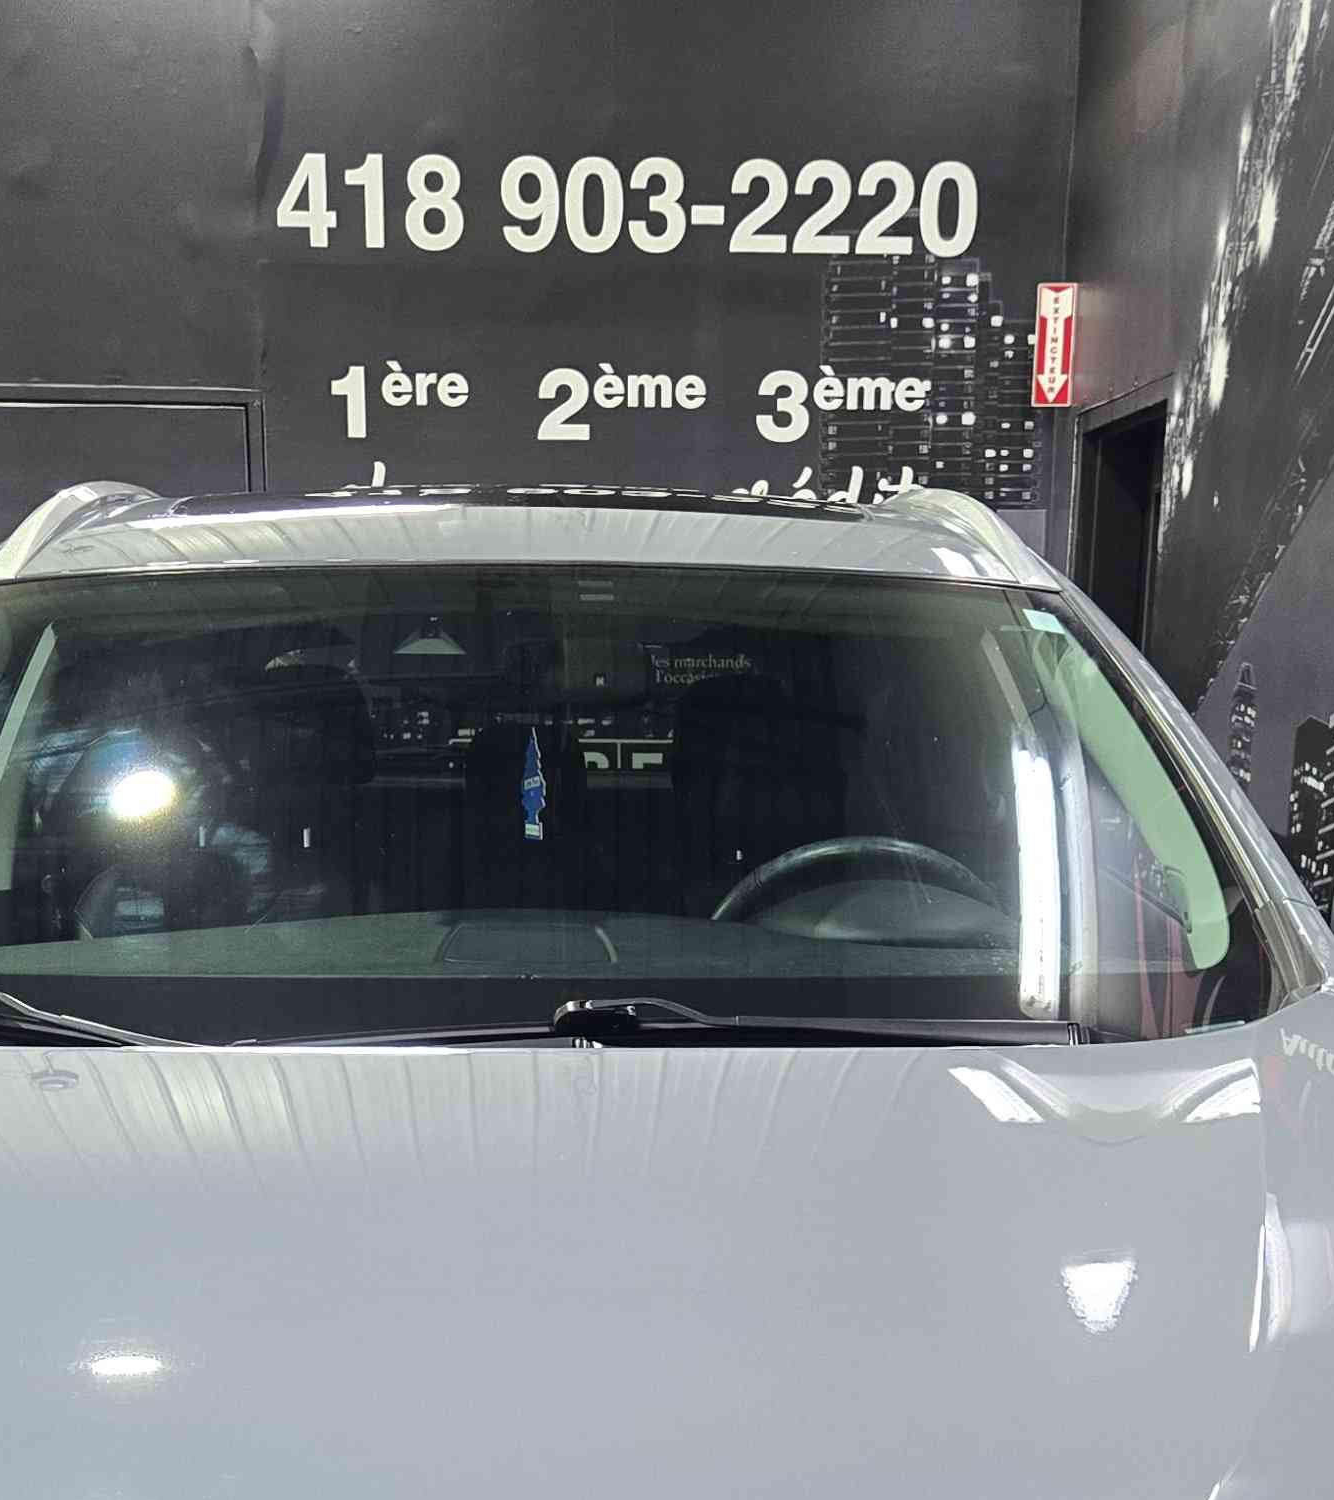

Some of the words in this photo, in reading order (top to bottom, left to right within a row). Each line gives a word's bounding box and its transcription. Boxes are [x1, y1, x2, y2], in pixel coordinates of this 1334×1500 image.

[276, 152, 464, 251] 418
[500, 156, 979, 256] 903-2220
[1046, 296, 1059, 394] EXTINCTEUR
[330, 361, 469, 439] 1ère
[537, 363, 707, 441] 2ème
[755, 366, 930, 443] 3ème
